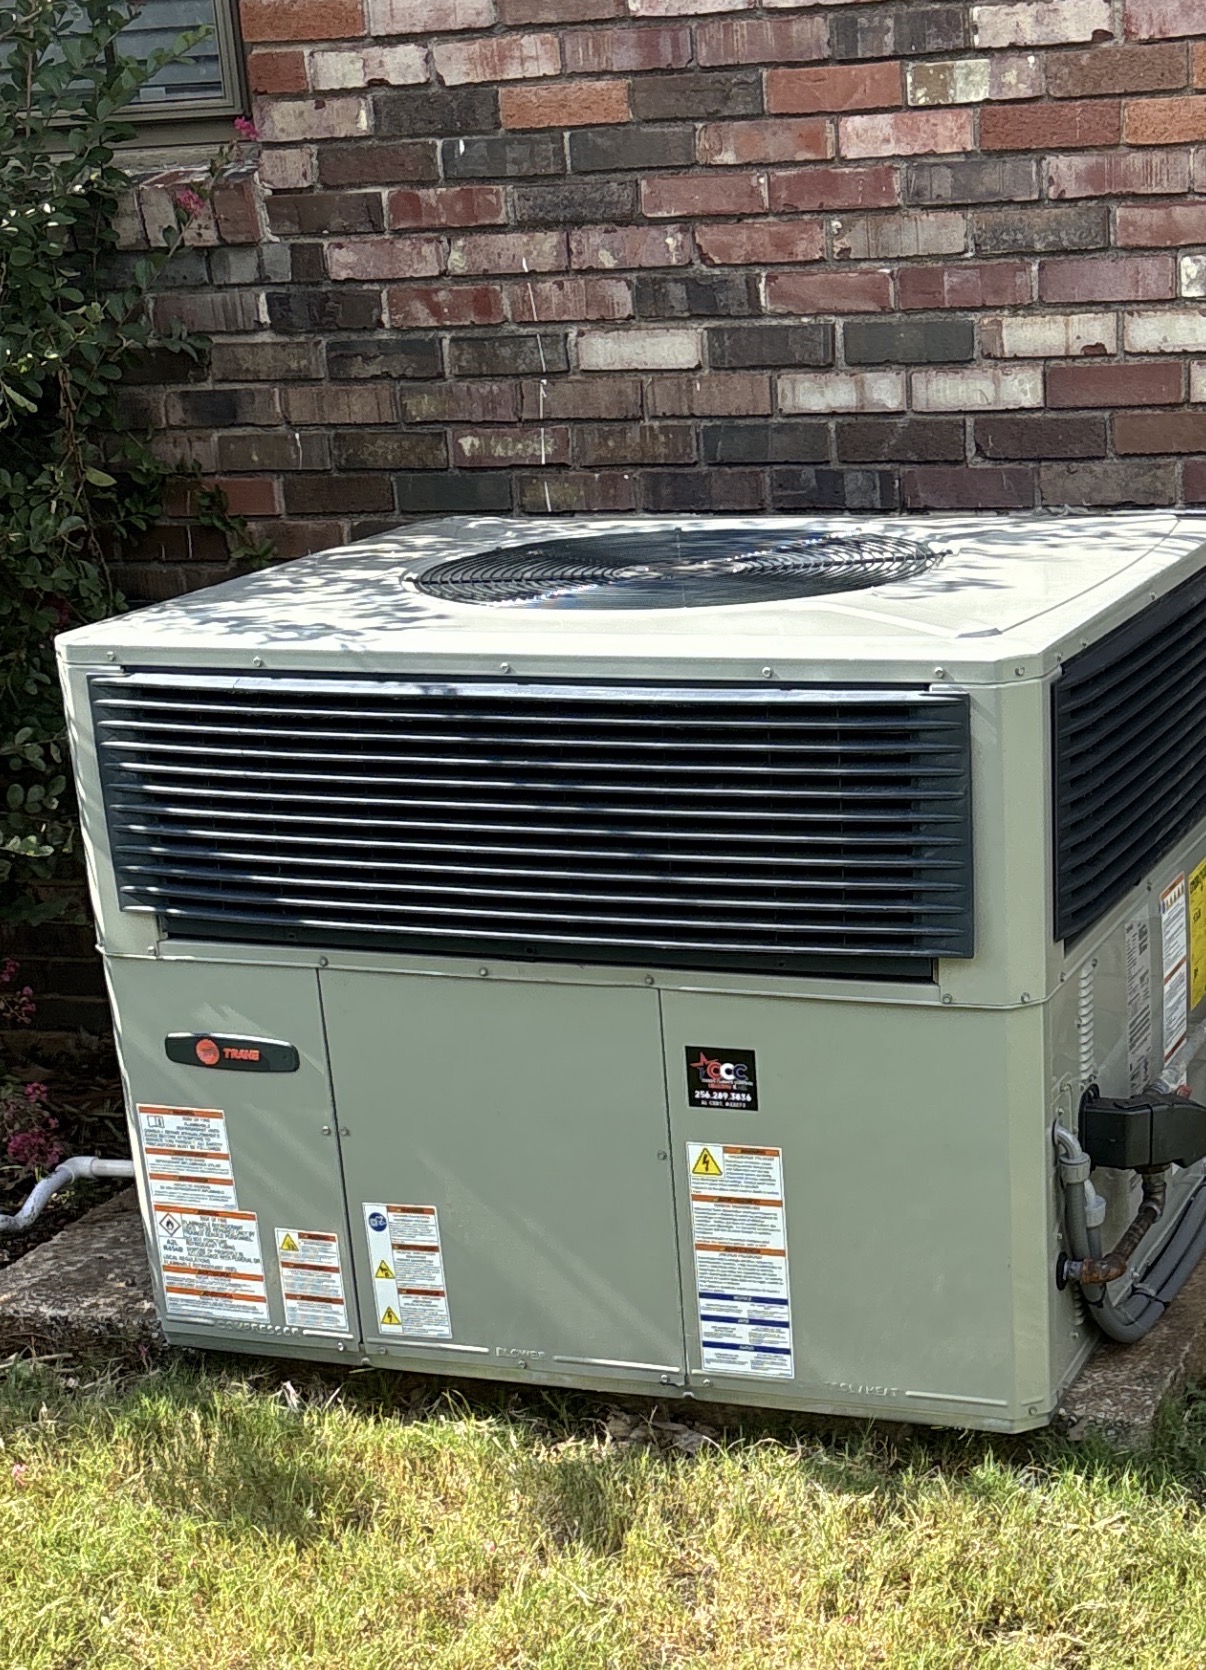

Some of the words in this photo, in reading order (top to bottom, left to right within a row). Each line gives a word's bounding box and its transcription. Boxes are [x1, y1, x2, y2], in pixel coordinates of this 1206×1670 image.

[223, 1048, 260, 1061] TRANE
[706, 1061, 749, 1081] CCC
[216, 1319, 301, 1338] COMPRESSOR
